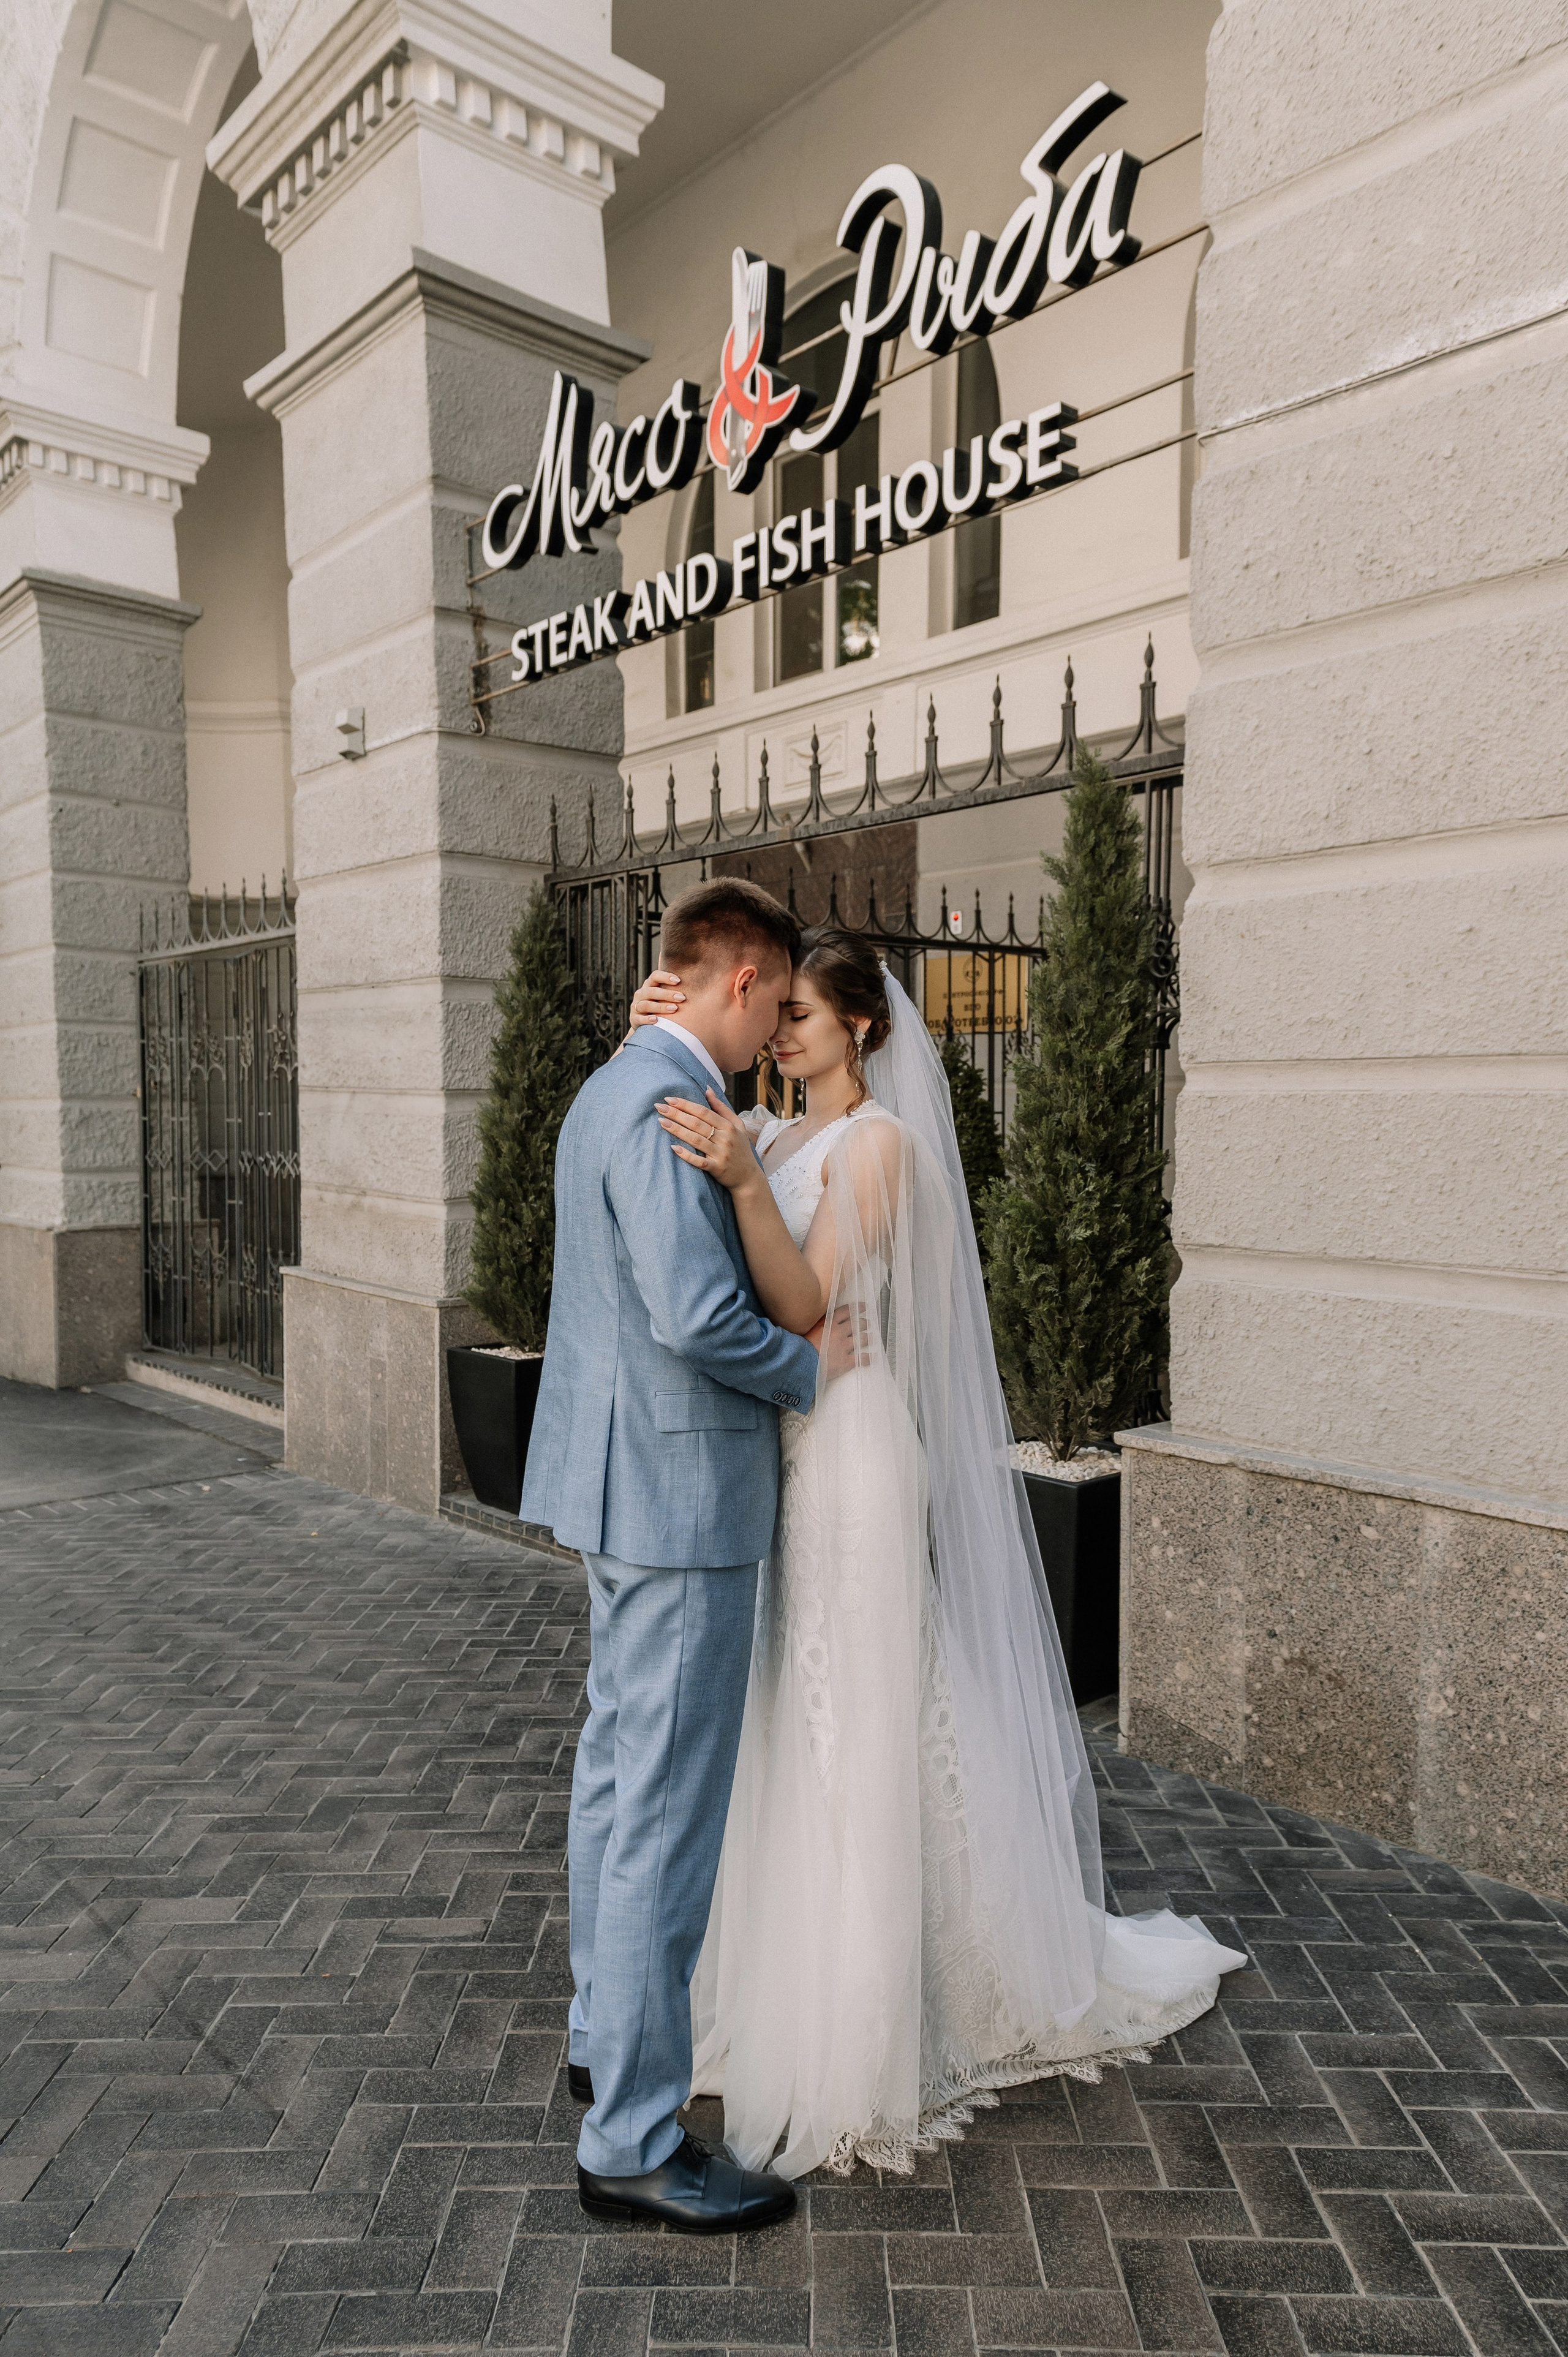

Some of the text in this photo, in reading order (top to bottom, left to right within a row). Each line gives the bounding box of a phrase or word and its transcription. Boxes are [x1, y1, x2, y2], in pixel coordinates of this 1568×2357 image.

[790, 80, 1126, 452] Рыба
[510, 401, 1063, 682] STEAK AND FISH HOUSE
